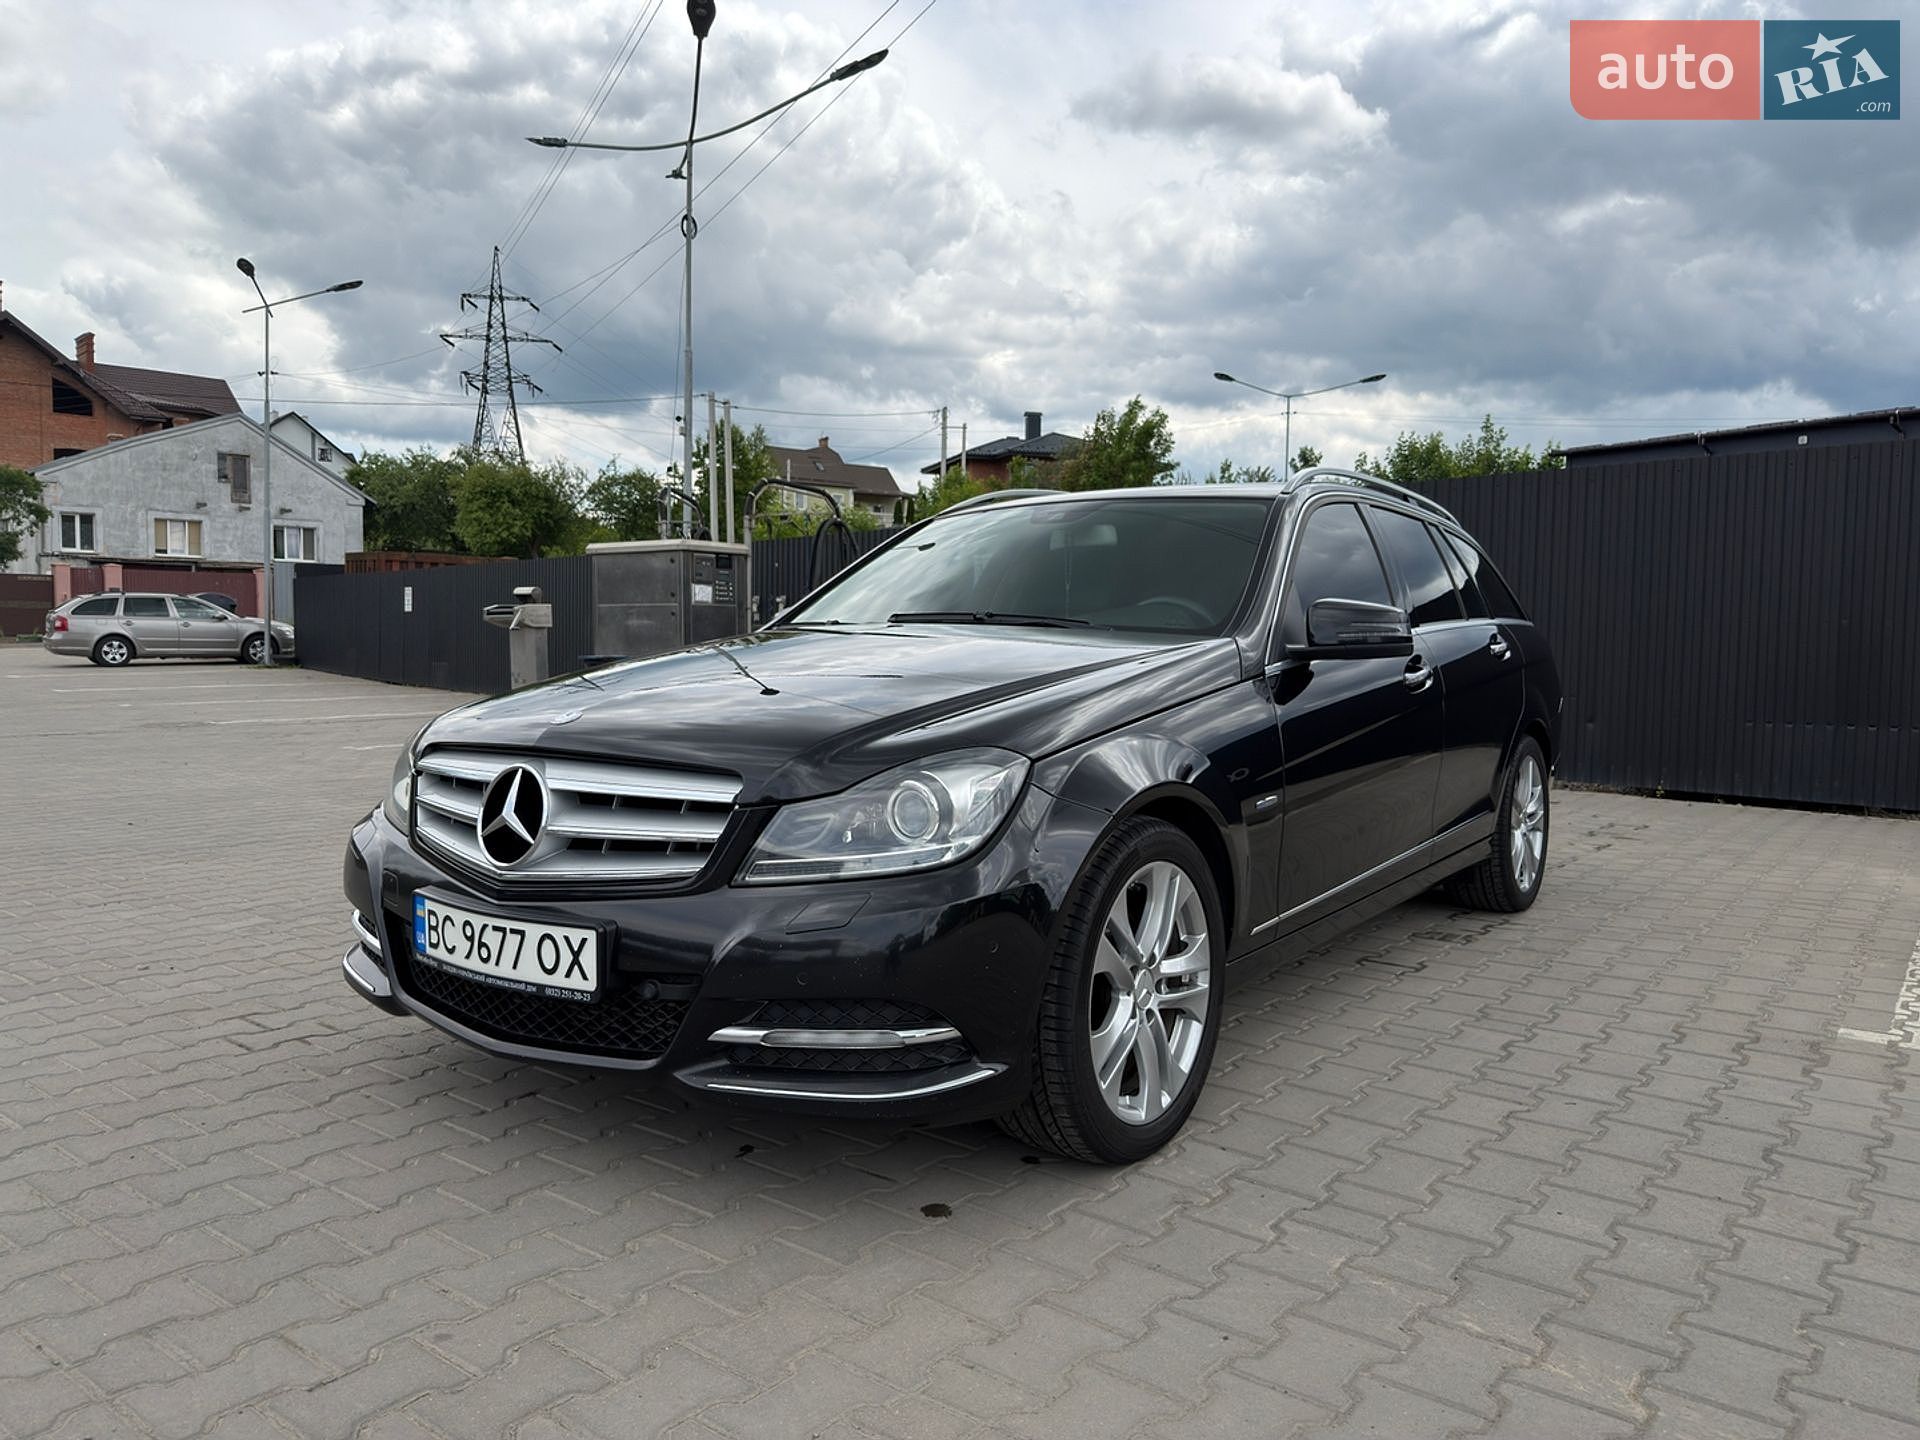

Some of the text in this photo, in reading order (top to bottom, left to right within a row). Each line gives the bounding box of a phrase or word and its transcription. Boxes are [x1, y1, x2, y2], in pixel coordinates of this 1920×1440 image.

[427, 909, 589, 981] BC 9677 OX
